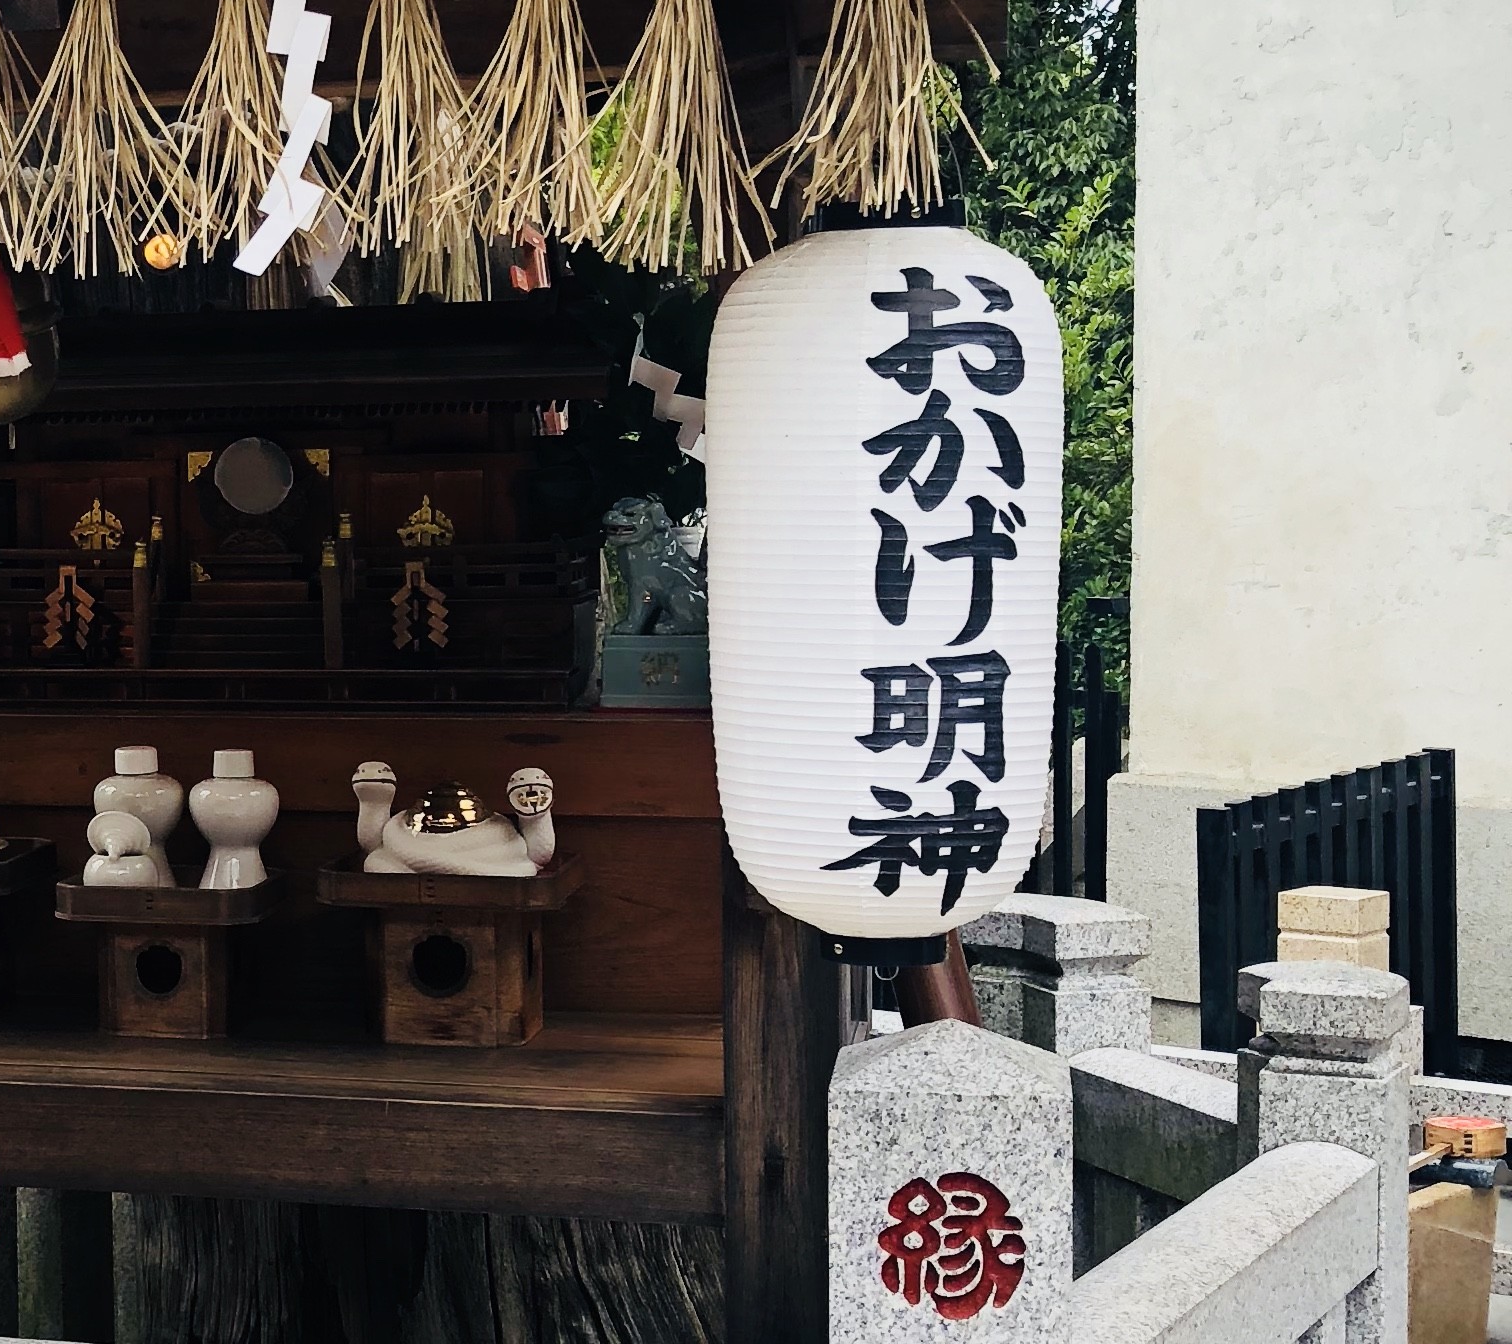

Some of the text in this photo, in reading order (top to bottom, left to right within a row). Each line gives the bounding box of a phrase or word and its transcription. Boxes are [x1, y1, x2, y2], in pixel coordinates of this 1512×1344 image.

[820, 267, 1026, 916] おかげ明神
